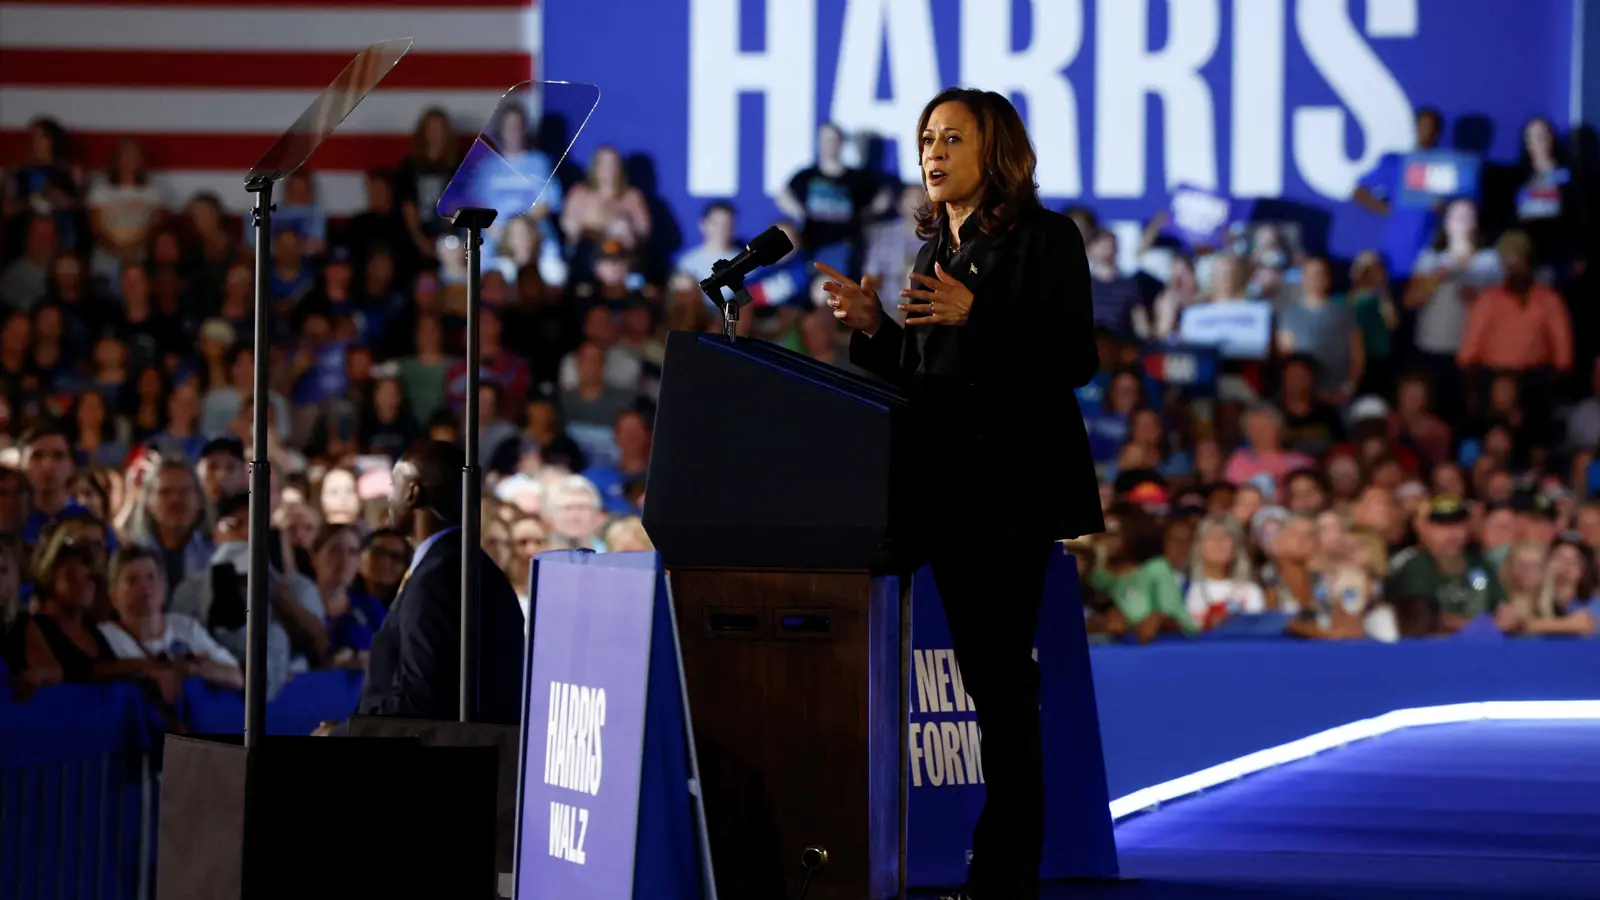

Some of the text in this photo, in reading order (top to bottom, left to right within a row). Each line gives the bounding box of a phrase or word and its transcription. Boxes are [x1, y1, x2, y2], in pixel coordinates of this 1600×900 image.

[687, 0, 1420, 200] HARRIS
[544, 681, 606, 796] HARRIS
[909, 721, 985, 787] FORW
[549, 801, 589, 865] WALZ
